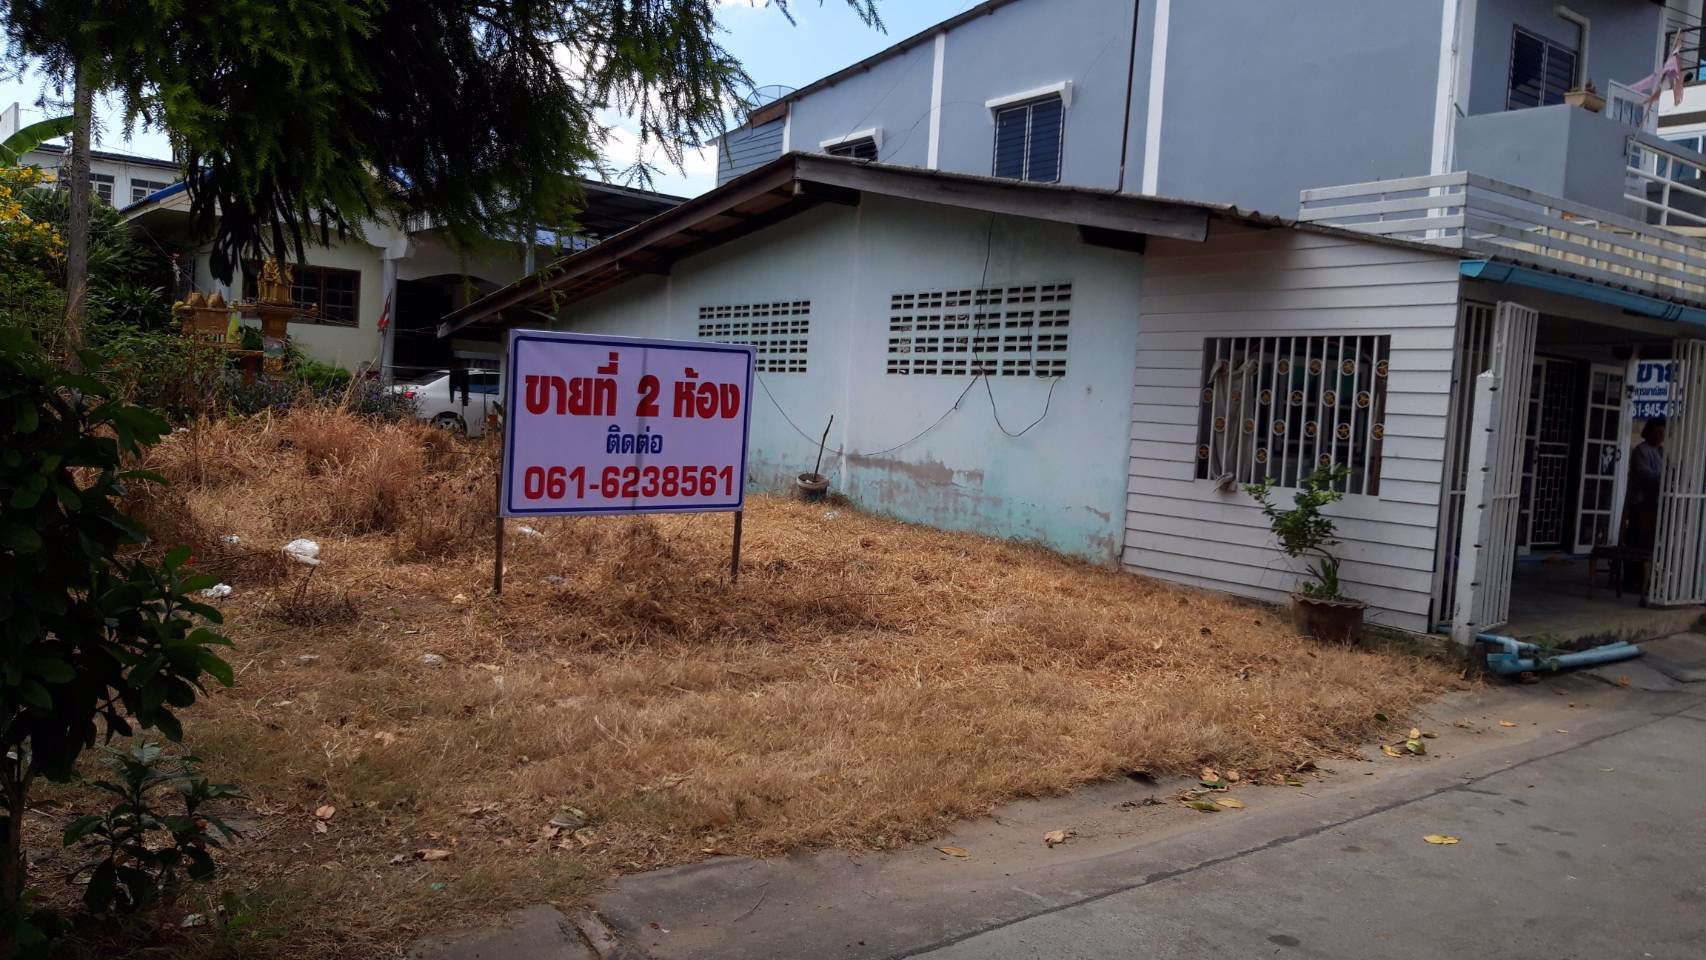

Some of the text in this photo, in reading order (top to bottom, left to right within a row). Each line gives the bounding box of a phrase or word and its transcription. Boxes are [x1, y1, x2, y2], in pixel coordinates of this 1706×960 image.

[525, 352, 741, 419] ขายที่ 2 ห้อง
[606, 424, 663, 454] ติดต่อ
[524, 465, 734, 500] 061-6238561
